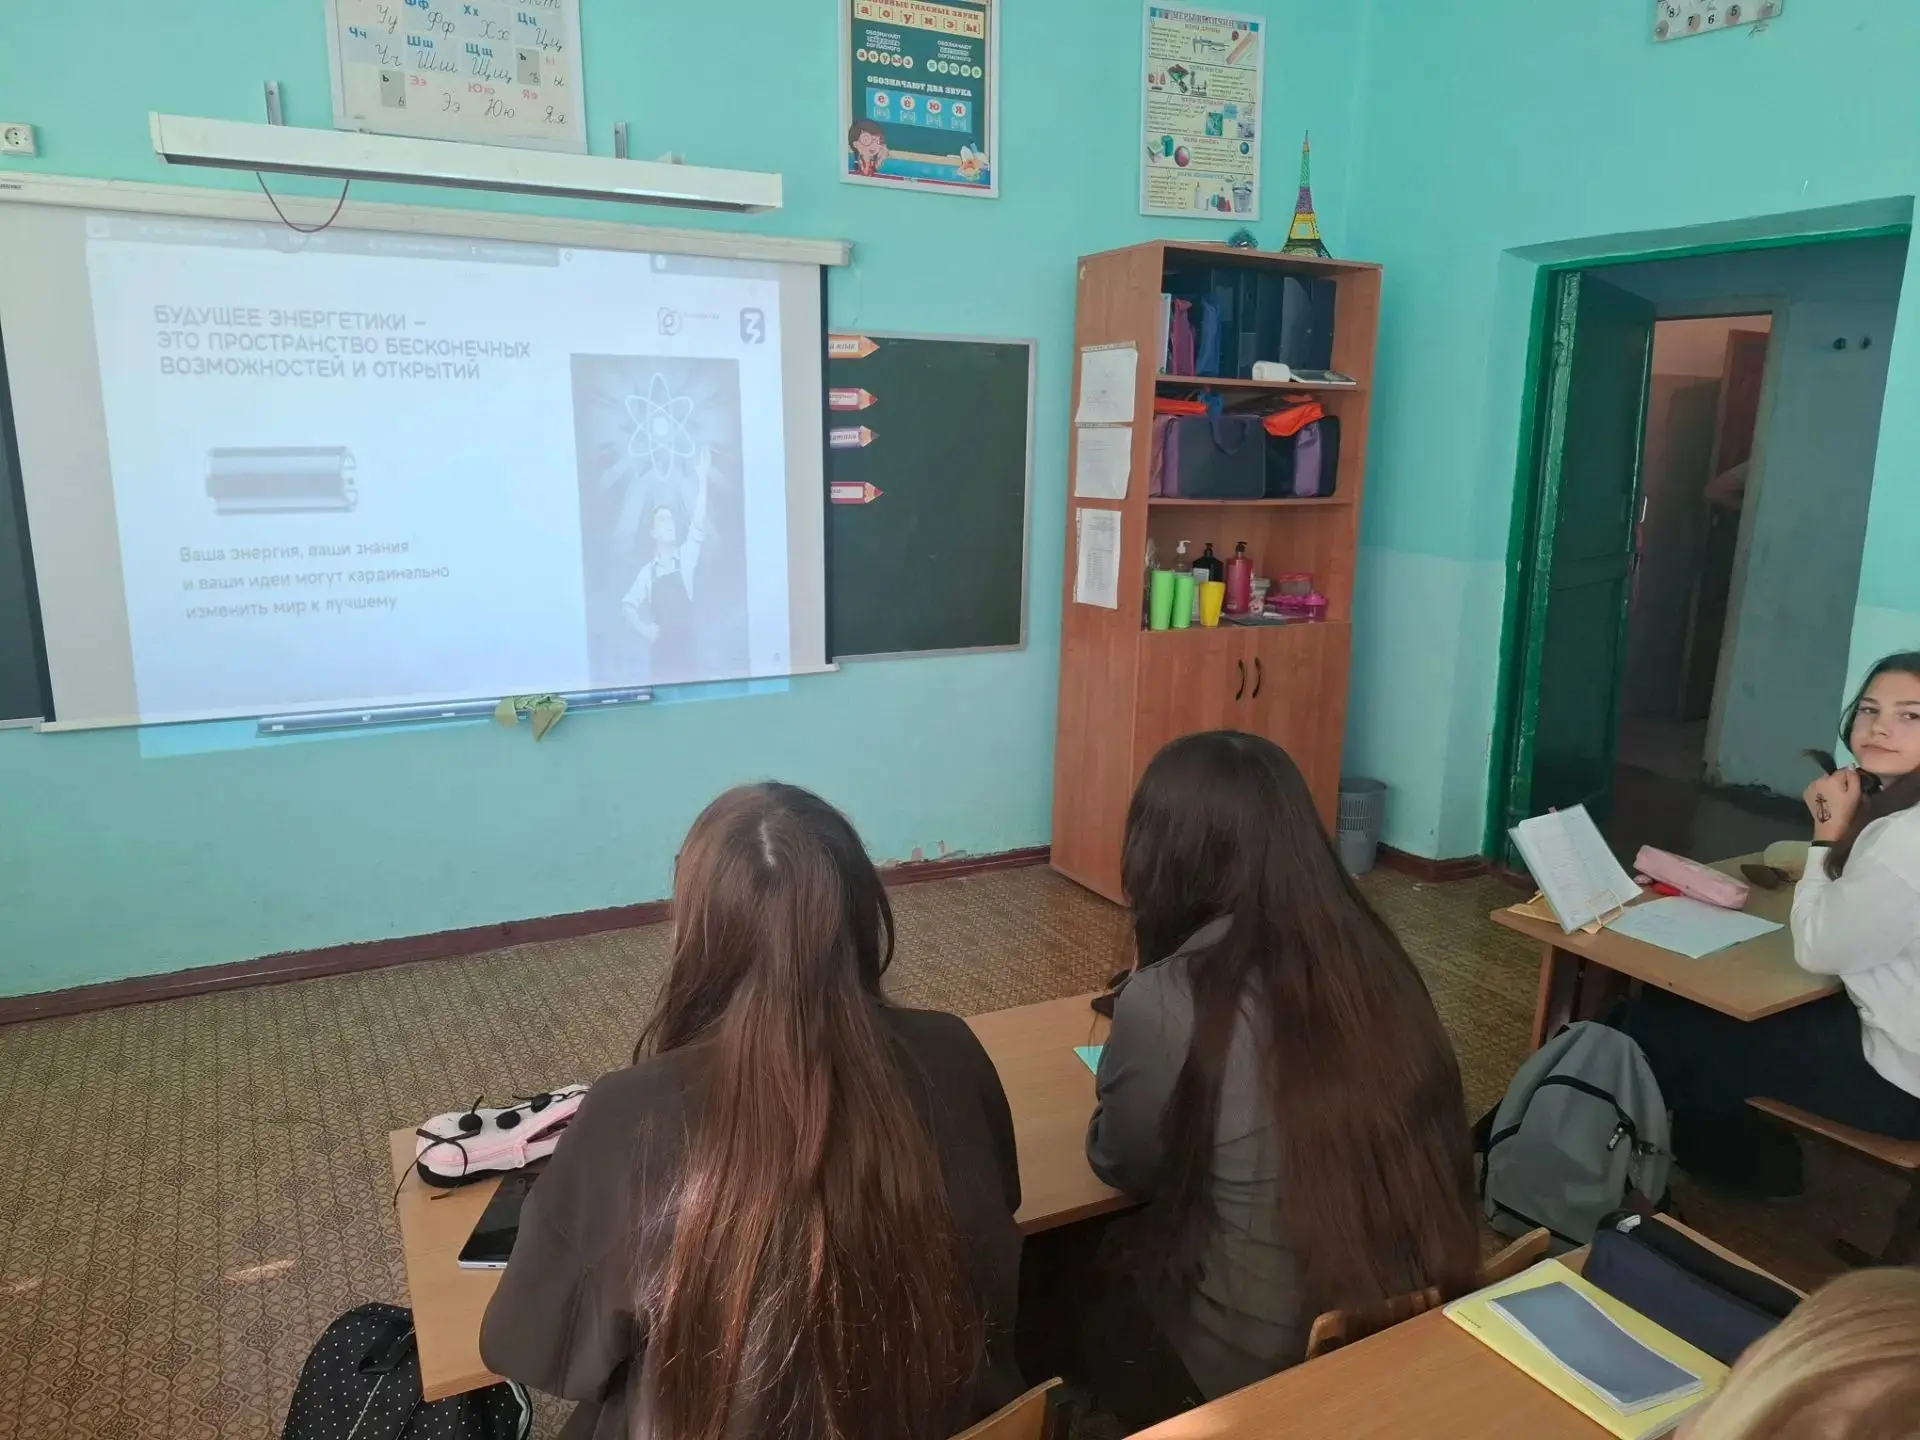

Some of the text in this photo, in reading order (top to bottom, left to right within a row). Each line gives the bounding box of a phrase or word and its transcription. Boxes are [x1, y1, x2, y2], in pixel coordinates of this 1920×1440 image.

[463, 4, 479, 17] Хх
[518, 12, 537, 26] Цц
[910, 3, 951, 15] ГЛАСНЫЕ
[951, 10, 979, 20] ЗВУКИ
[349, 26, 368, 39] Чч
[407, 35, 434, 49] Шш
[465, 42, 494, 58] Щщ
[867, 75, 973, 97] ОБОЗНАЧАЮТ ДВА ЗВУКА
[154, 304, 263, 327] БУДУЩЕЕ
[268, 309, 406, 331] ЭНЕРГЕТИКИ
[157, 330, 531, 358] ЭТО ПРОСТРАНСТВО БЕСКОНЕЧНЫХ
[160, 354, 480, 380] ВОЗМОЖНОСТЕЙ И ОТКРЫТИЙ
[180, 541, 410, 563] Ваша энергия, ваши знания
[183, 565, 450, 591] и ваши идеи могут кардинально
[186, 595, 397, 619] изменить мир к лучшему
